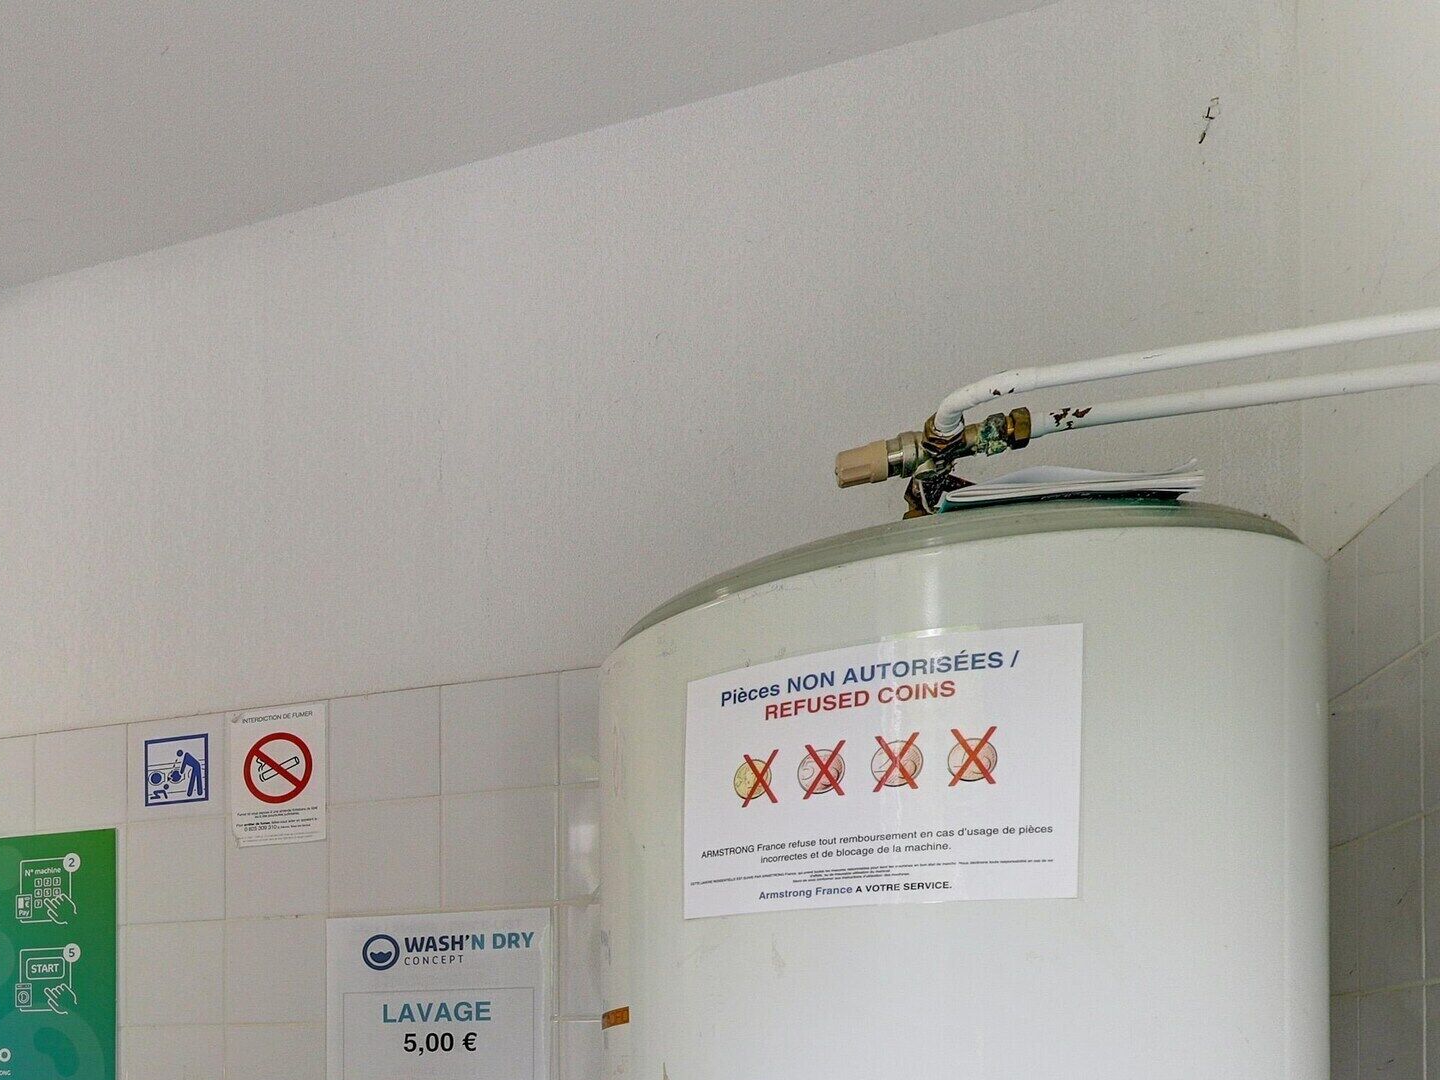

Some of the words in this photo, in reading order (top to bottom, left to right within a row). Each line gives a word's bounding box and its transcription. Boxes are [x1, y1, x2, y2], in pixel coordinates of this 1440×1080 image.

[721, 682, 780, 707] Pièces
[787, 671, 835, 694] NON
[842, 650, 1004, 685] AUTORISÉES
[1010, 650, 1020, 668] /
[764, 690, 870, 721] REFUSED
[877, 680, 956, 703] COINS
[242, 714, 282, 724] INTERDICTION
[292, 710, 313, 719] FUMER
[701, 844, 755, 859] ARMSTRONG
[757, 842, 786, 852] France
[788, 839, 816, 849] refuse
[819, 837, 837, 846] tout
[839, 831, 917, 845] remboursement
[957, 827, 999, 837] d'usage
[1002, 826, 1016, 835] de
[1018, 825, 1053, 835] pièces
[68, 858, 75, 868] 2
[760, 853, 808, 864] incorrectes
[810, 851, 819, 859] et
[821, 849, 834, 858] de
[836, 846, 874, 858] blocage
[877, 845, 890, 854] de
[892, 844, 902, 853] la
[904, 842, 952, 851] machine.
[35, 867, 61, 875] machine
[759, 888, 812, 900] Armstrong
[815, 885, 853, 896] France
[855, 885, 862, 893] A
[865, 883, 901, 892] VOTRE
[903, 881, 953, 891] SERVICE.
[404, 933, 485, 953] WASH'N
[492, 931, 535, 950] DRY
[68, 948, 75, 957] 5
[404, 954, 464, 966] CONCEPT
[31, 963, 59, 973] START
[382, 1001, 491, 1023] LAVAGE
[403, 1032, 454, 1056] 5,00
[462, 1032, 477, 1052] €
